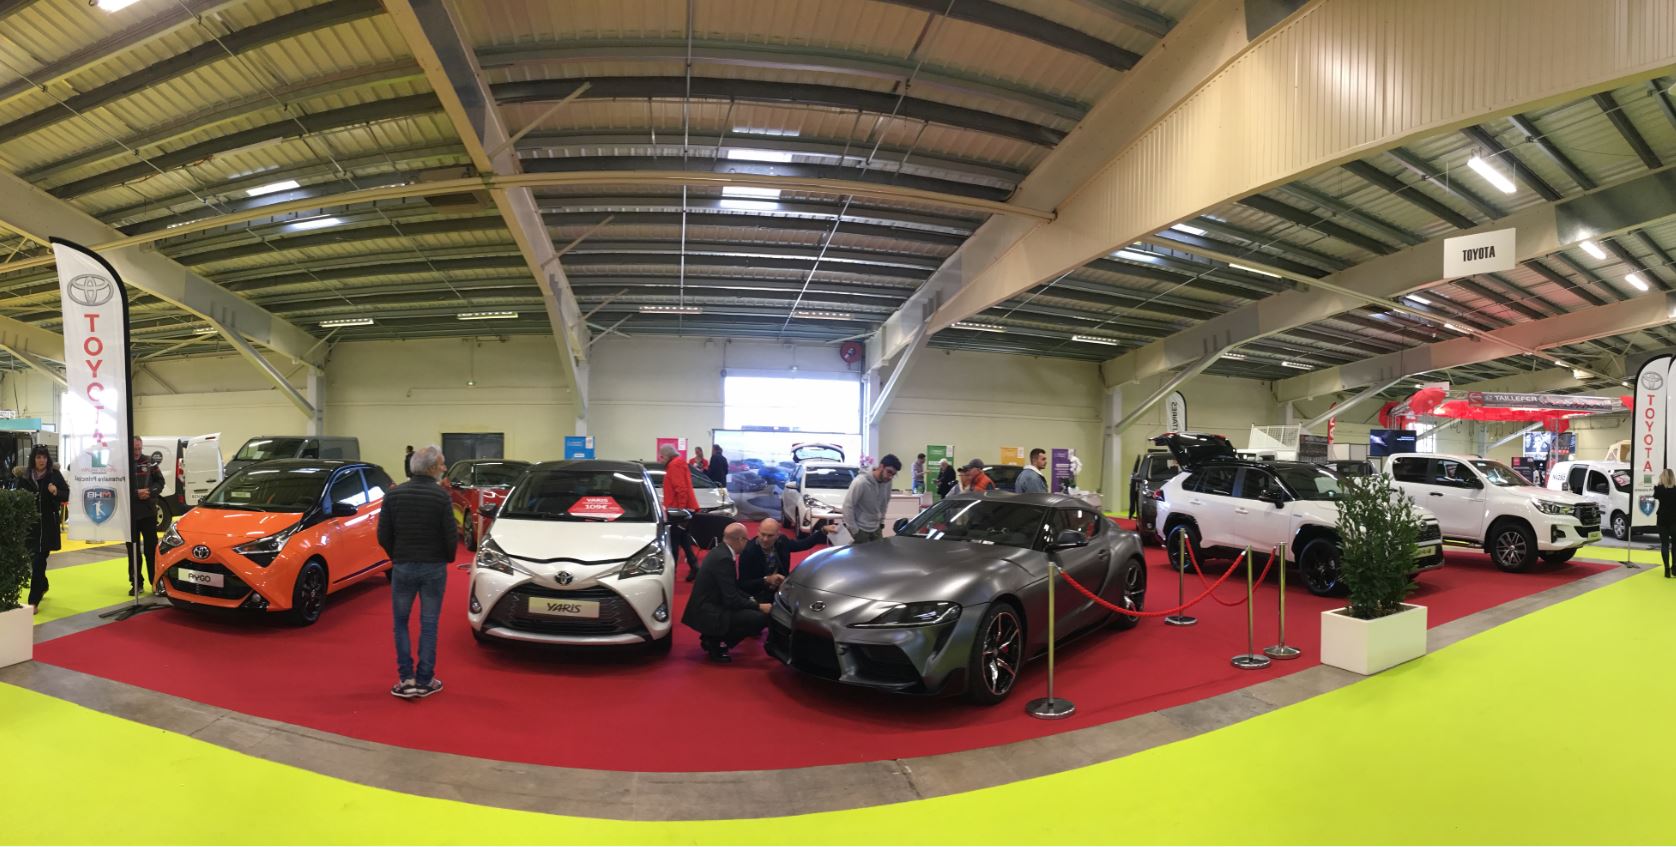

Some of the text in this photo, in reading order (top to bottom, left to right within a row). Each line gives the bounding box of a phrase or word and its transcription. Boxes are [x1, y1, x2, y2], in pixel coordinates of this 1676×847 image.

[1462, 245, 1496, 262] TOYOTA
[1643, 394, 1656, 472] TOYOTA
[546, 602, 582, 614] YARIS
